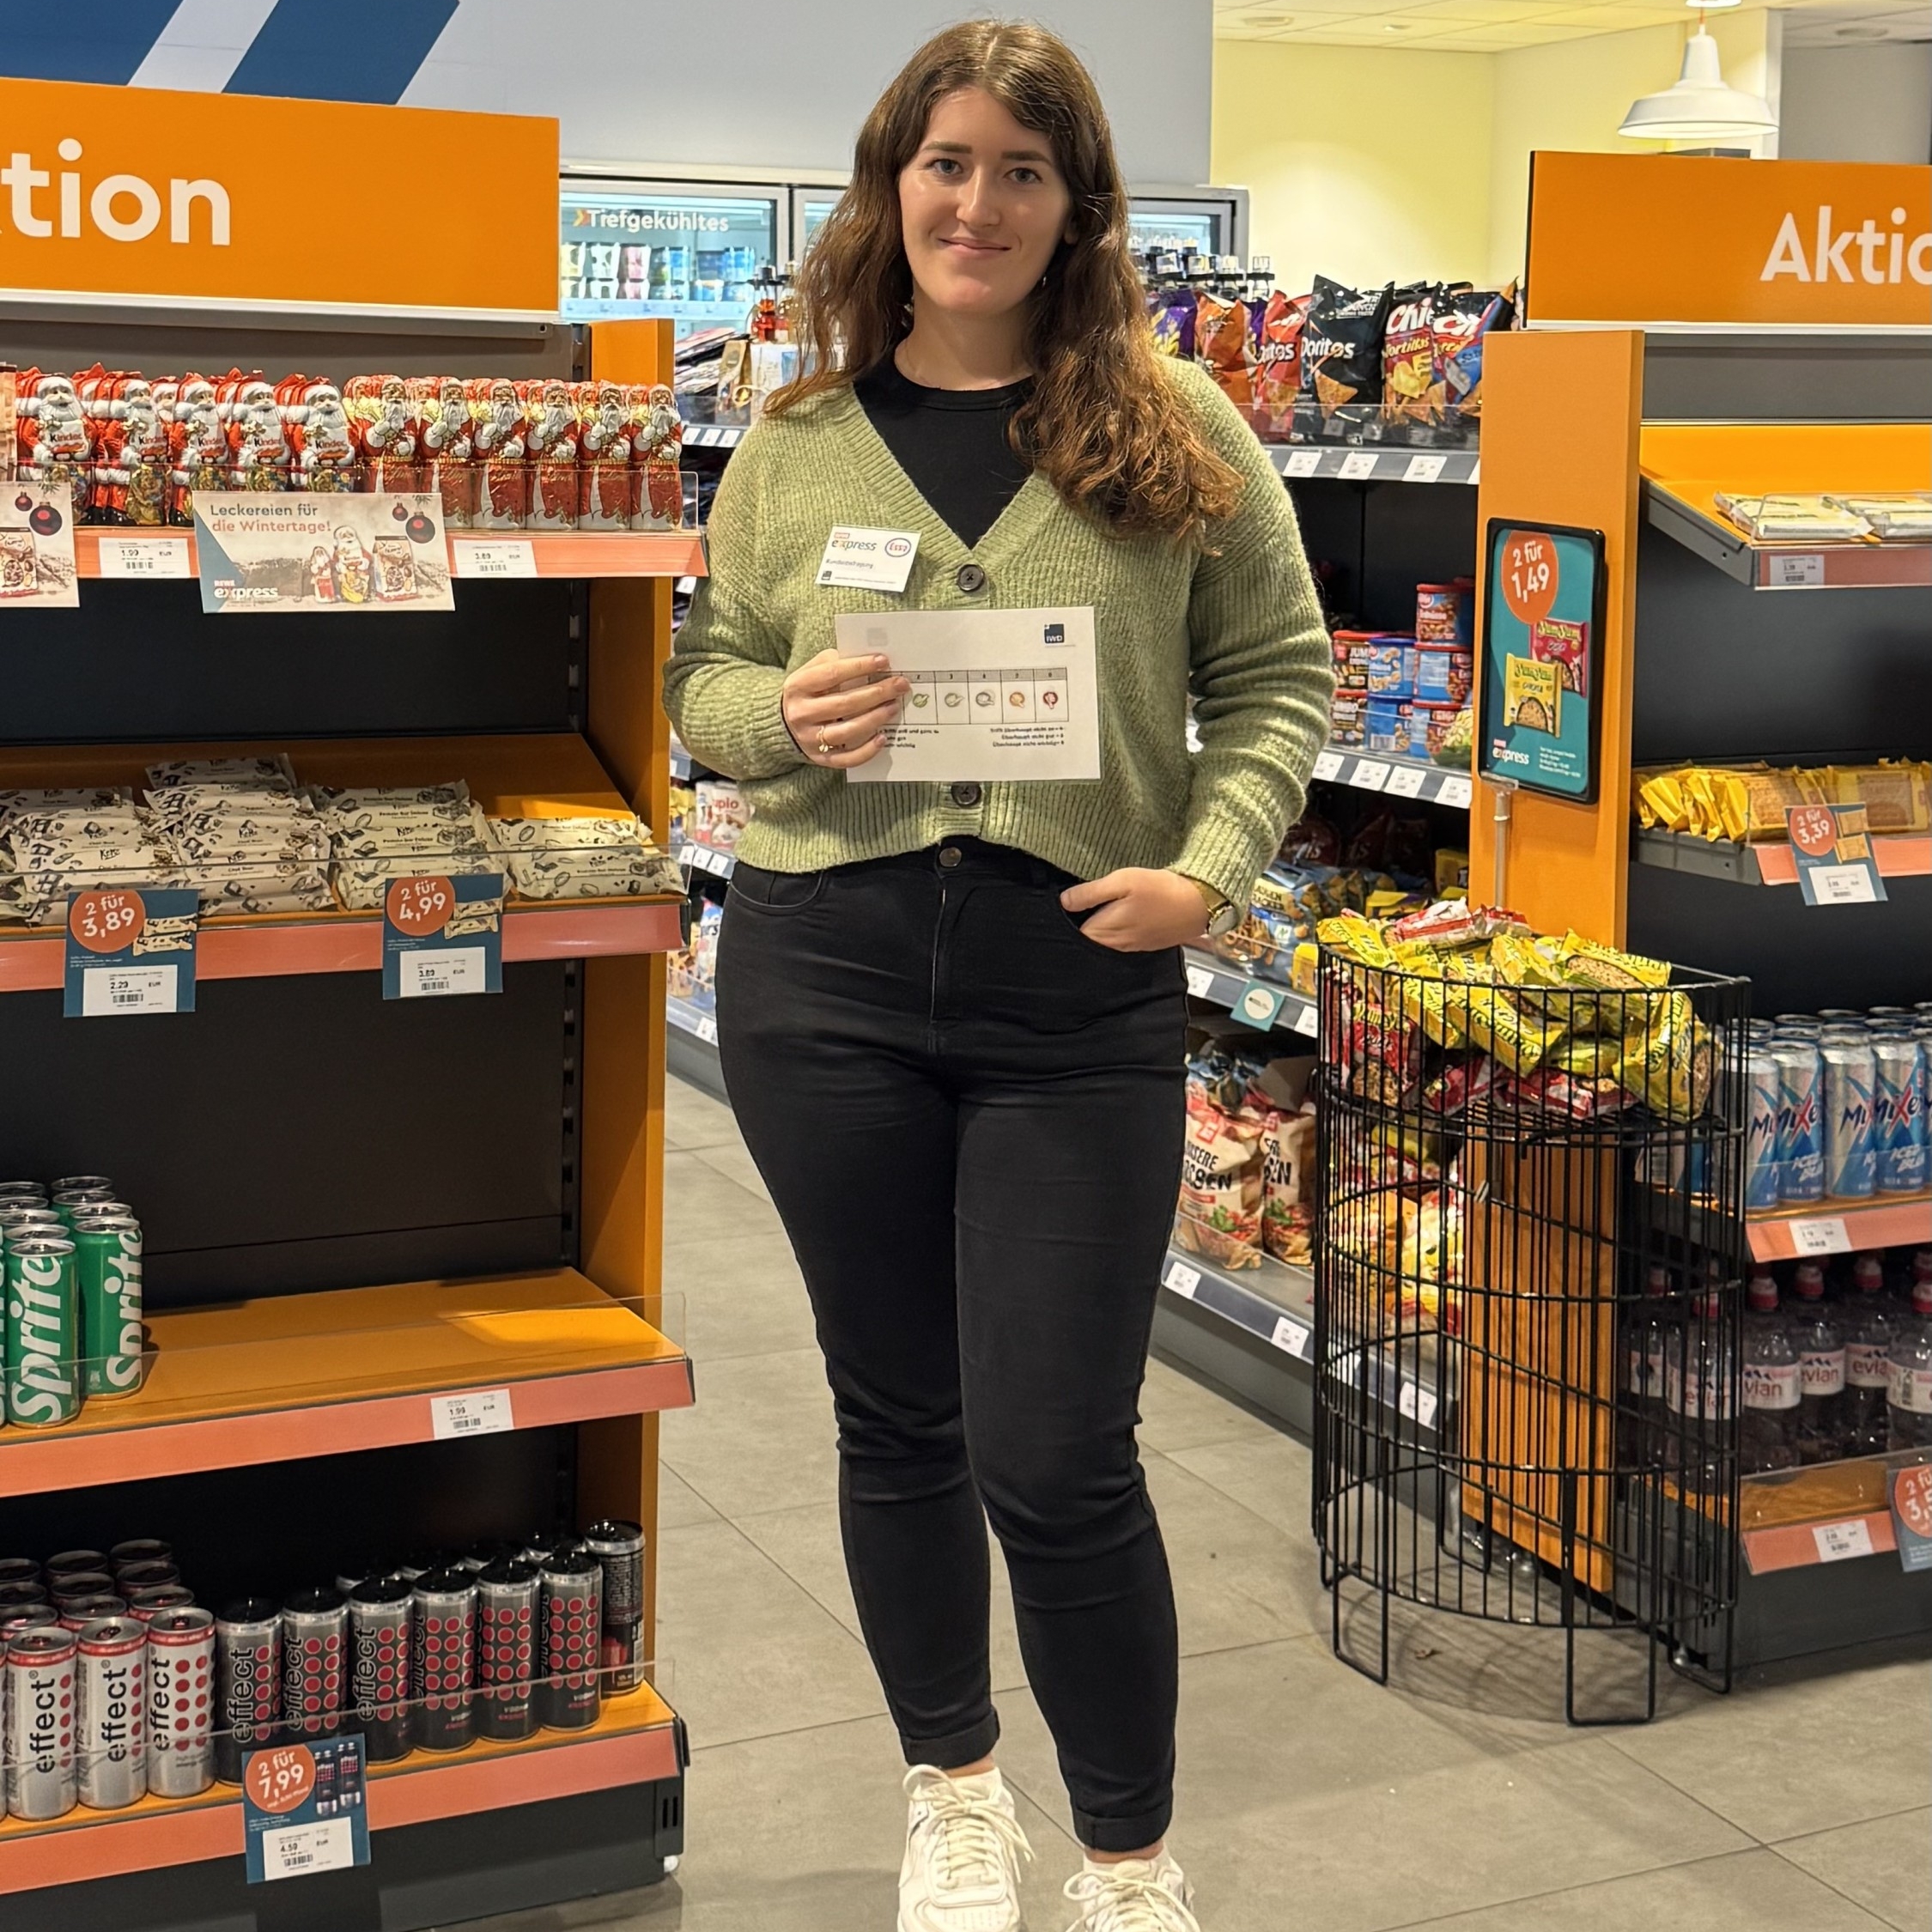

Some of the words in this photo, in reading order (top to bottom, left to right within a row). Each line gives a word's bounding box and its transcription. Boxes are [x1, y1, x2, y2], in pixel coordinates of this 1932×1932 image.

[0, 137, 231, 246] tion
[586, 209, 729, 233] Tiefgekühltes
[1301, 336, 1355, 359] Doritos
[210, 502, 293, 516] Leckereien
[297, 503, 319, 516] für
[212, 519, 235, 532] die
[240, 519, 332, 535] Wintertage!
[830, 538, 878, 552] express
[1512, 548, 1522, 567] 2
[1524, 540, 1544, 563] für
[214, 586, 279, 600] express
[1511, 562, 1550, 603] 1,49
[1796, 816, 1806, 827] 2
[1806, 809, 1821, 823] für
[1798, 819, 1830, 845] 3,39
[85, 902, 97, 915] 2
[100, 895, 125, 911] für
[400, 888, 412, 902] 2
[415, 880, 437, 896] für
[398, 892, 447, 922] 4,99
[82, 907, 136, 939] 3,89
[10, 1255, 72, 1423] Sprite
[1852, 1358, 1888, 1376] evia
[1744, 1379, 1783, 1398] vian
[1906, 1479, 1917, 1496] 2
[1917, 1467, 1932, 1490] fü
[1905, 1488, 1932, 1521] 3,5
[285, 1634, 304, 1730] effect
[352, 1626, 378, 1722] effect
[149, 1657, 170, 1752] effect
[226, 1646, 254, 1744] effect
[30, 1677, 55, 1774] effect
[101, 1667, 127, 1762] effect
[258, 1762, 270, 1777] 2
[272, 1751, 296, 1771] für
[258, 1763, 305, 1800] 7,99
